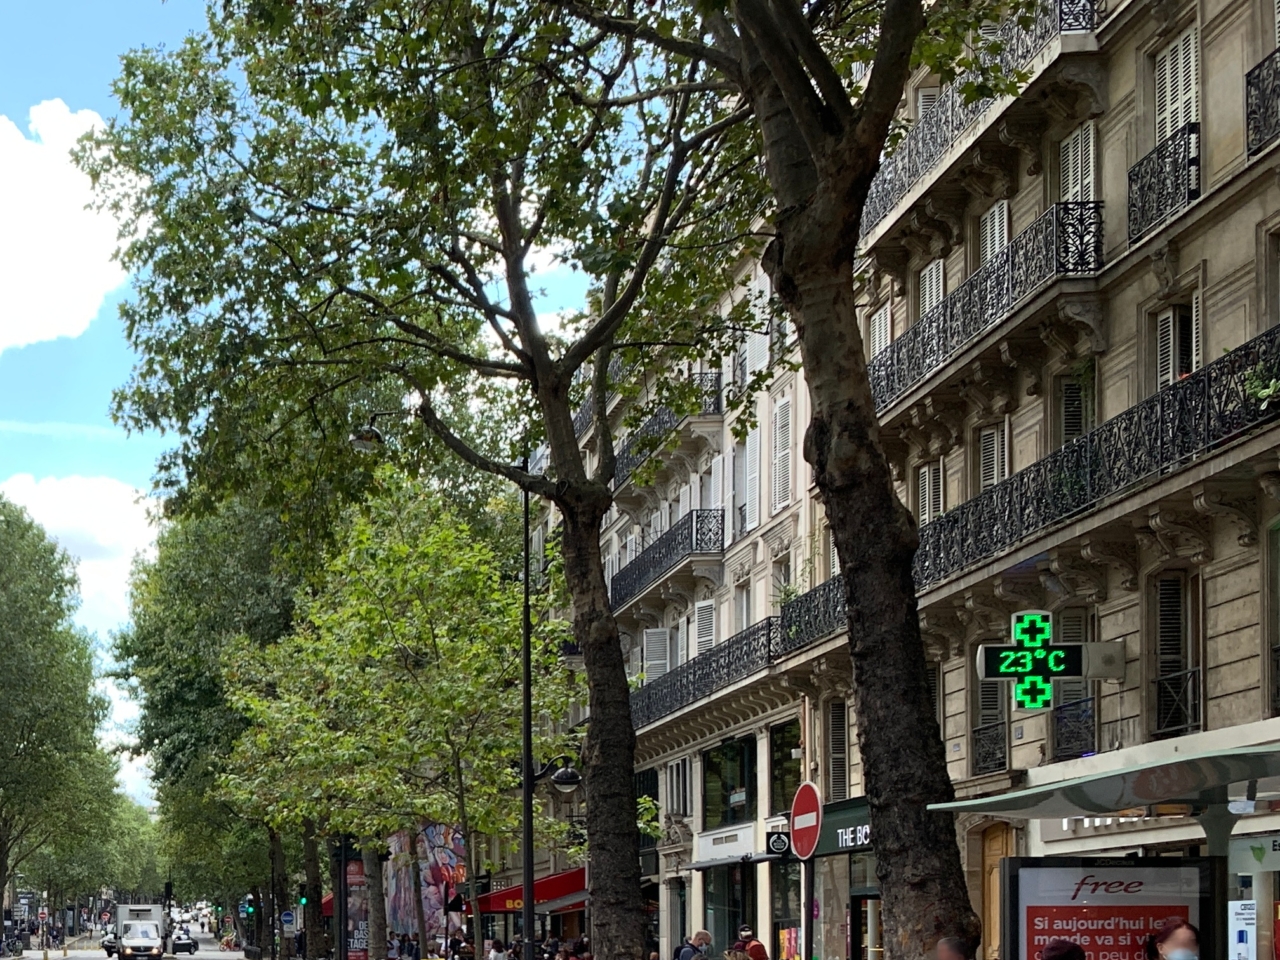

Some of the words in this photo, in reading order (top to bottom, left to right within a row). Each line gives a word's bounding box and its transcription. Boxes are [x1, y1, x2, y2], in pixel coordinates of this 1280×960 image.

[999, 649, 1065, 672] 23°C
[837, 826, 855, 847] THE
[856, 824, 870, 845] BO
[1071, 875, 1144, 901] free
[1033, 917, 1049, 930] Si
[1052, 917, 1144, 933] aujourd'hui
[1095, 935, 1114, 946] va
[1118, 933, 1131, 946] si
[1137, 933, 1151, 946] vi
